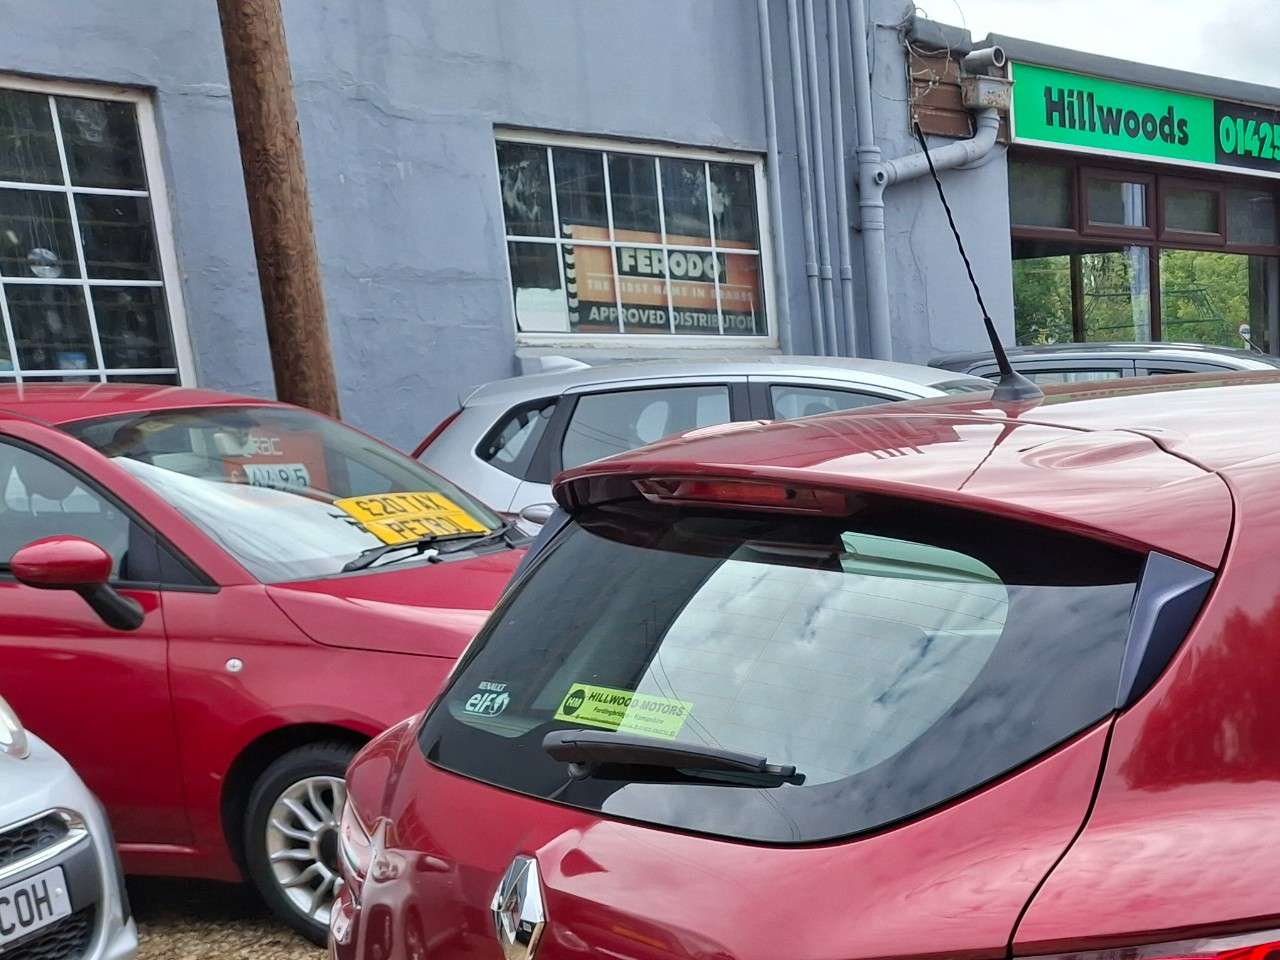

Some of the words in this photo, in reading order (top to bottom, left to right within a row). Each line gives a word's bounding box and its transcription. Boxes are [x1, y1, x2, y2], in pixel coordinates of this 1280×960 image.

[1044, 86, 1190, 146] Hillwoods
[621, 248, 721, 278] FERODO
[588, 305, 666, 325] APPROVED
[672, 311, 754, 330] DISTRIBUTOR
[355, 496, 405, 517] £20
[398, 494, 447, 513] TAX
[385, 514, 470, 540] PETROL
[465, 693, 497, 712] elf
[588, 691, 639, 709] HILLWOOD
[640, 700, 686, 717] MOTORS
[0, 879, 53, 936] COH
